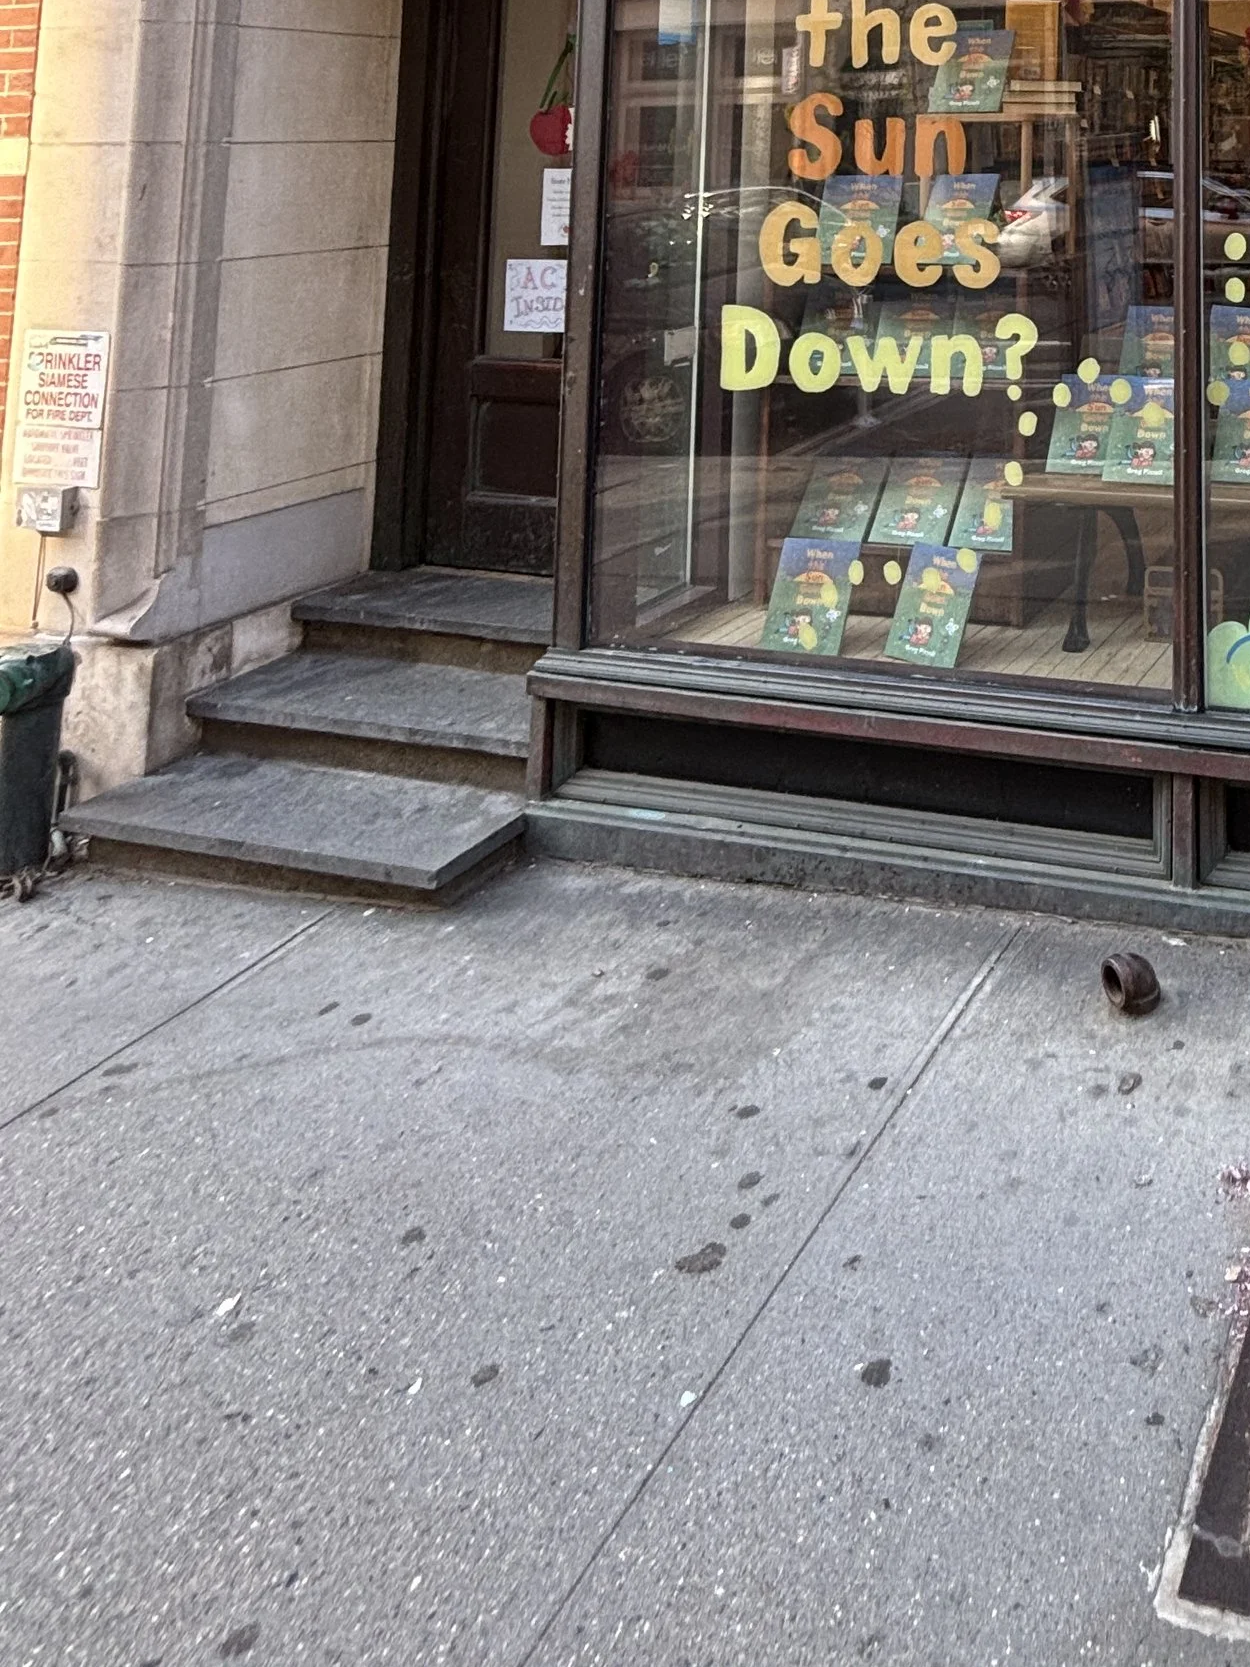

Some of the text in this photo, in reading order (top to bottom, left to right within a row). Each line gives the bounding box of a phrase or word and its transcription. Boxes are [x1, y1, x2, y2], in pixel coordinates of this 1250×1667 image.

[788, 91, 967, 180] Sun
[758, 200, 1002, 290] Goes
[521, 266, 558, 290] AC
[511, 295, 565, 318] INSID
[720, 305, 1039, 402] Down?
[38, 372, 88, 389] SIAMESE
[1087, 383, 1110, 392] Whe
[24, 390, 99, 409] CONNECTION
[1086, 402, 1107, 411] Sun
[25, 408, 44, 420] FOR
[46, 410, 66, 421] FIRE
[1080, 423, 1109, 432] Down
[1137, 428, 1167, 439] Down
[806, 548, 834, 559] When
